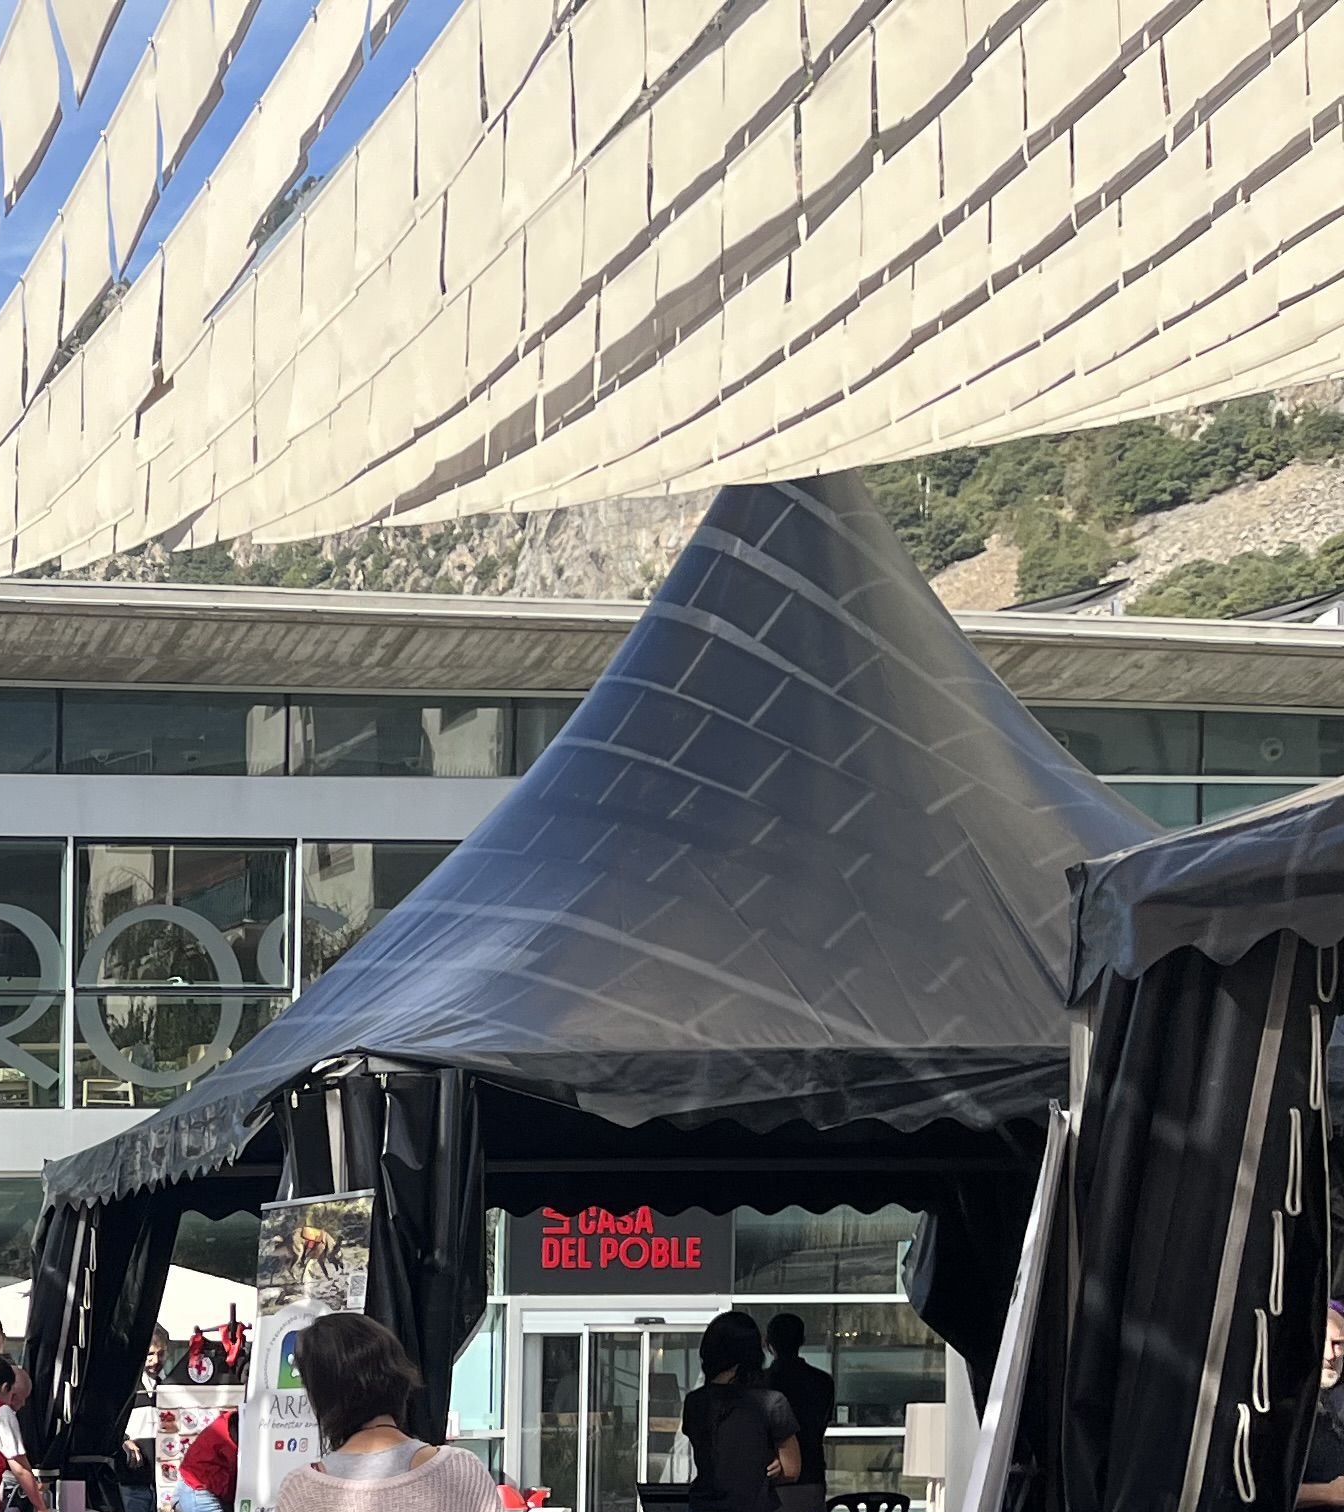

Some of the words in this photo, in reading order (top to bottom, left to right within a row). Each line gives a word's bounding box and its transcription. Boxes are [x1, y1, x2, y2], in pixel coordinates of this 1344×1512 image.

[578, 1205, 655, 1235] CASA
[541, 1237, 594, 1269] DEL
[599, 1237, 702, 1269] POBLE
[269, 1394, 312, 1420] ARP
